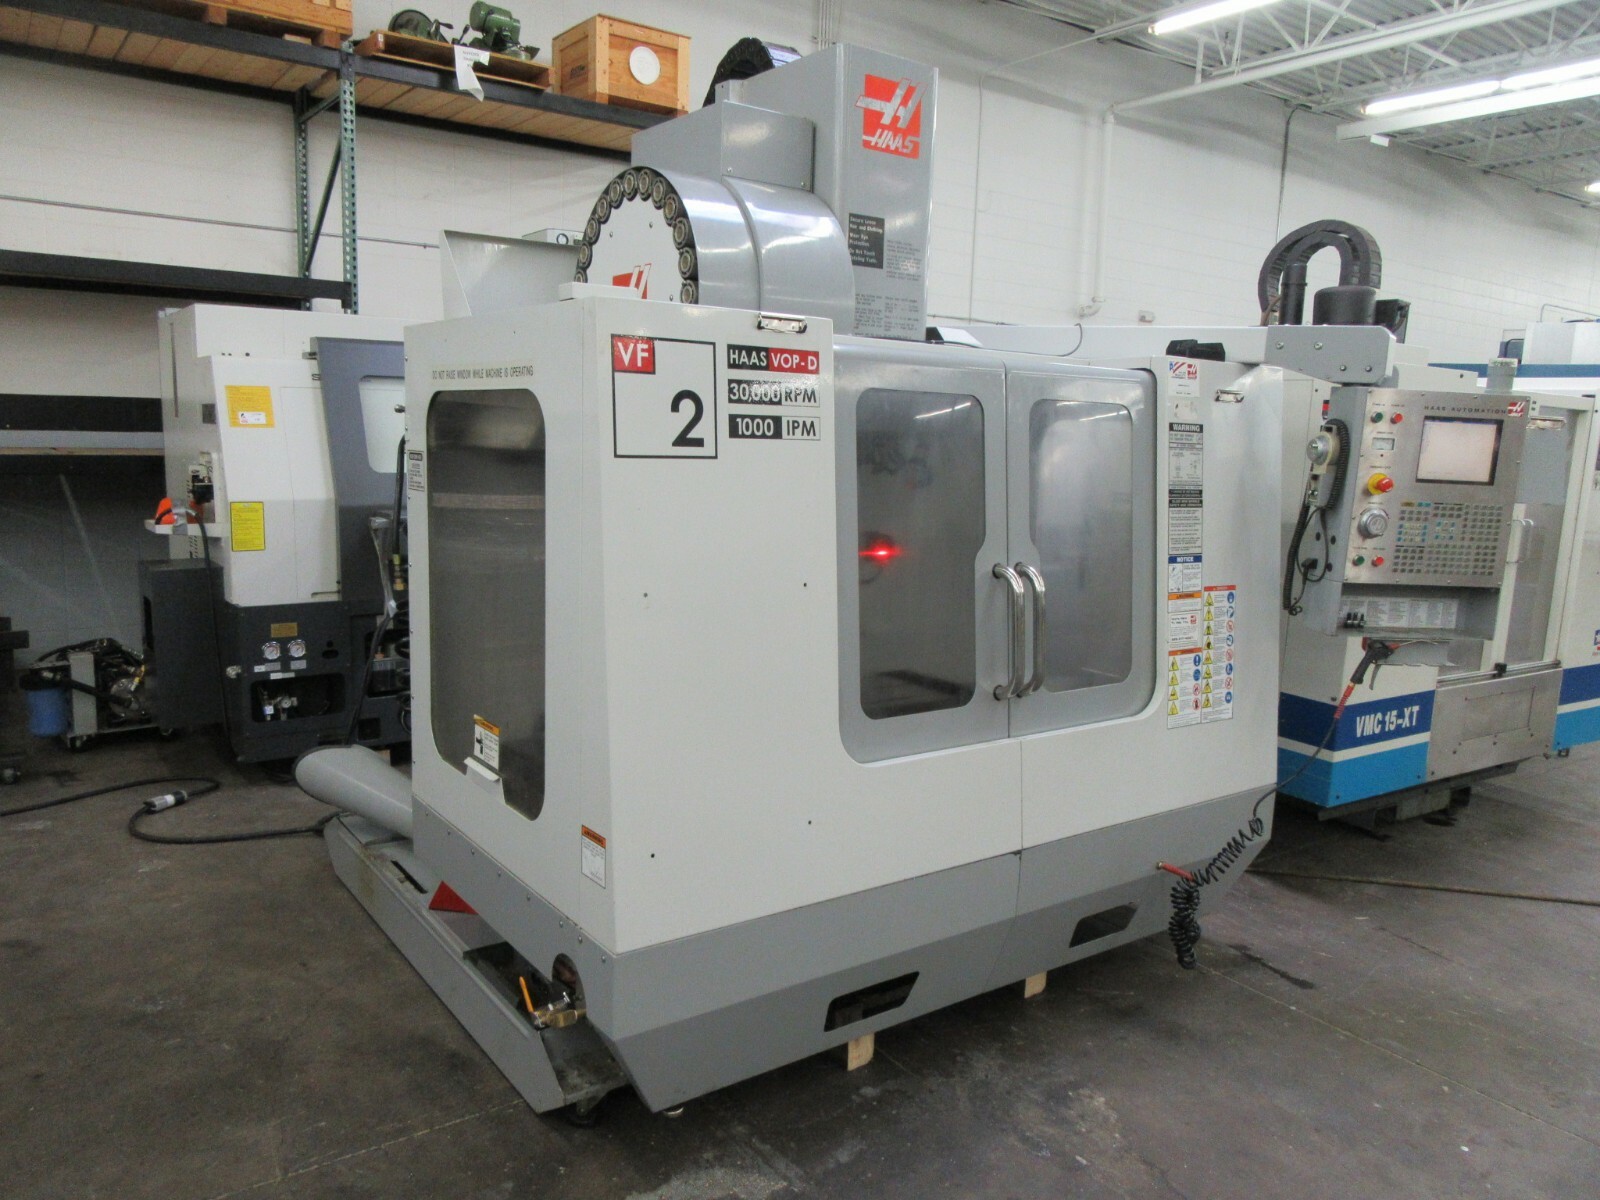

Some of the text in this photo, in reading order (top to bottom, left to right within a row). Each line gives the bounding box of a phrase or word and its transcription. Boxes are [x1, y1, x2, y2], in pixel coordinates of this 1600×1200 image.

[862, 128, 921, 154] HAAS
[617, 341, 649, 368] VF
[729, 349, 767, 367] HAAS
[457, 369, 472, 379] WINDOW
[473, 368, 484, 379] WHILE
[485, 367, 503, 378] MACHINE
[510, 365, 534, 377] OPERATING
[729, 383, 817, 404] 30,000 RPM
[670, 389, 705, 448] 2
[1451, 407, 1506, 415] AUTOMATION
[736, 417, 817, 437] 1000 IPM
[1172, 423, 1201, 432] WARNING
[1356, 705, 1420, 738] VMC 15-XT
